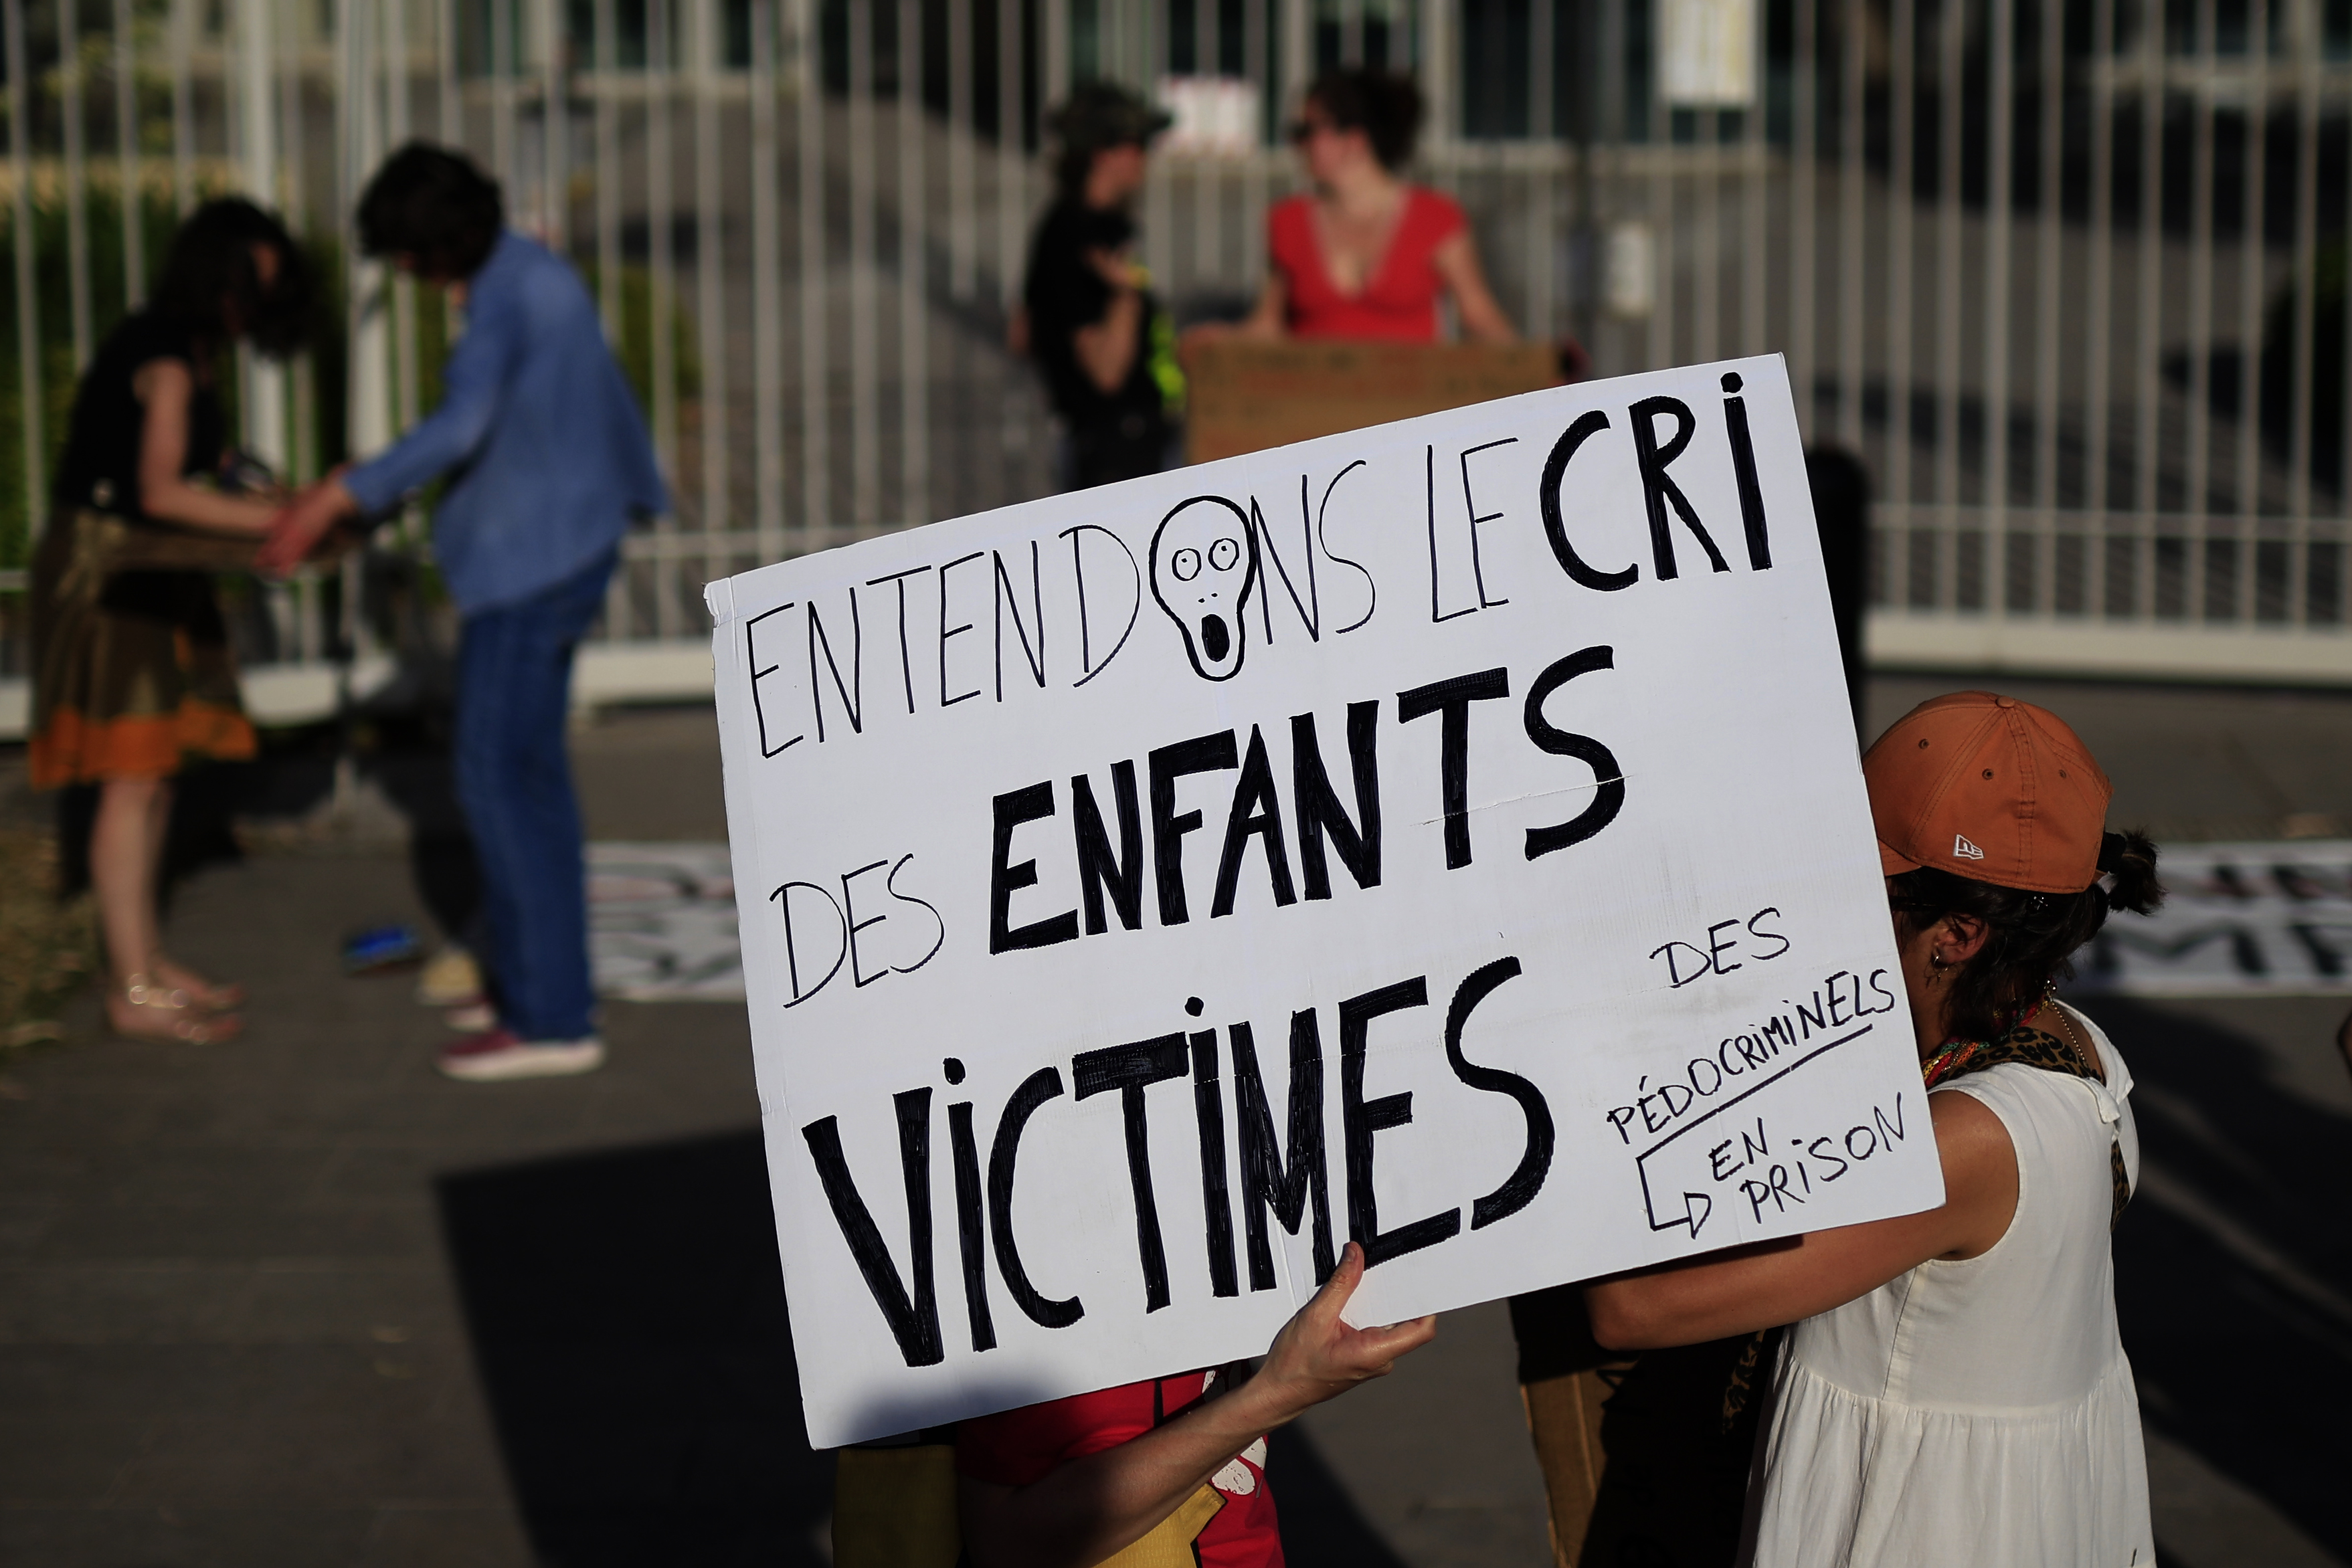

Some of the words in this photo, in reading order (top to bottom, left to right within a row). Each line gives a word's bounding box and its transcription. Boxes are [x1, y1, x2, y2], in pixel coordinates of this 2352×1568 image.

[1427, 437, 1518, 623] LE
[770, 854, 944, 1008] DES
[990, 646, 1625, 955] ENFANTS
[1649, 907, 1789, 988] DES
[1708, 1117, 1768, 1182] EN
